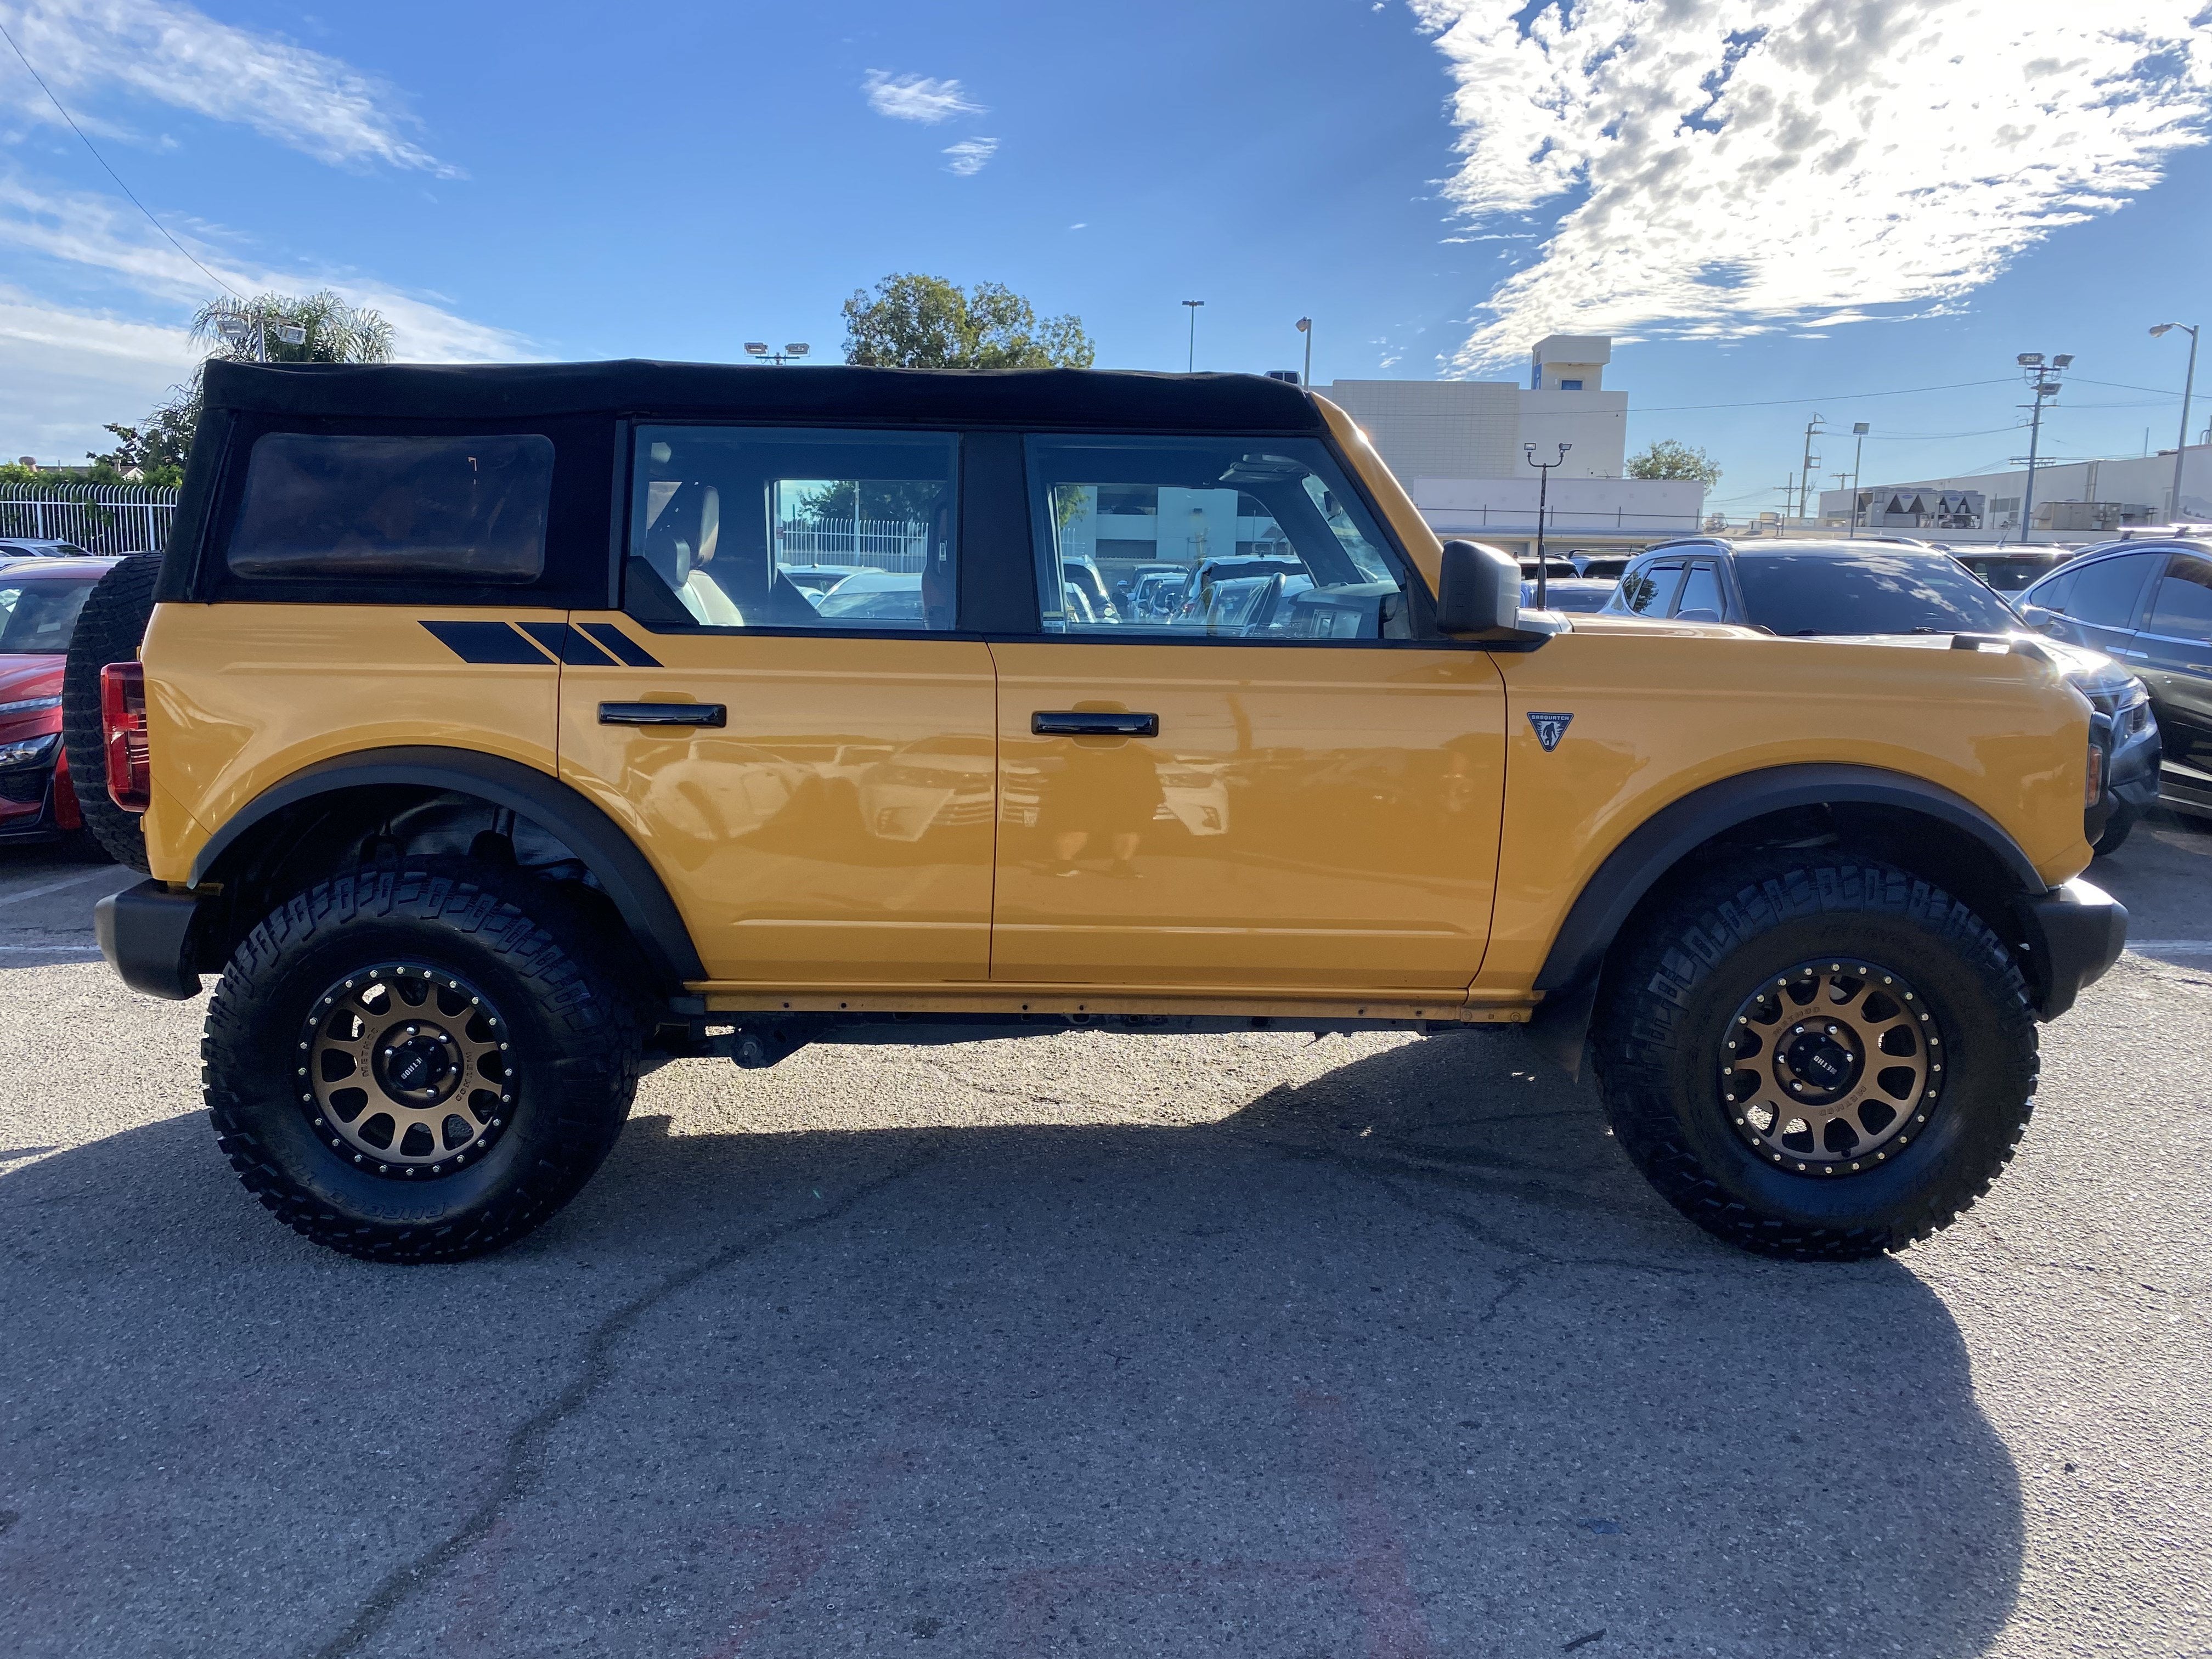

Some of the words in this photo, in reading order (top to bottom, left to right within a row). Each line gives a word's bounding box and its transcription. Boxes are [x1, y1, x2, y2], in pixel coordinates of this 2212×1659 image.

[361, 1028, 379, 1077] METHOD
[1813, 1056, 1838, 1075] METHO
[455, 1052, 473, 1102] METHOD
[1818, 1086, 1867, 1116] METHOD
